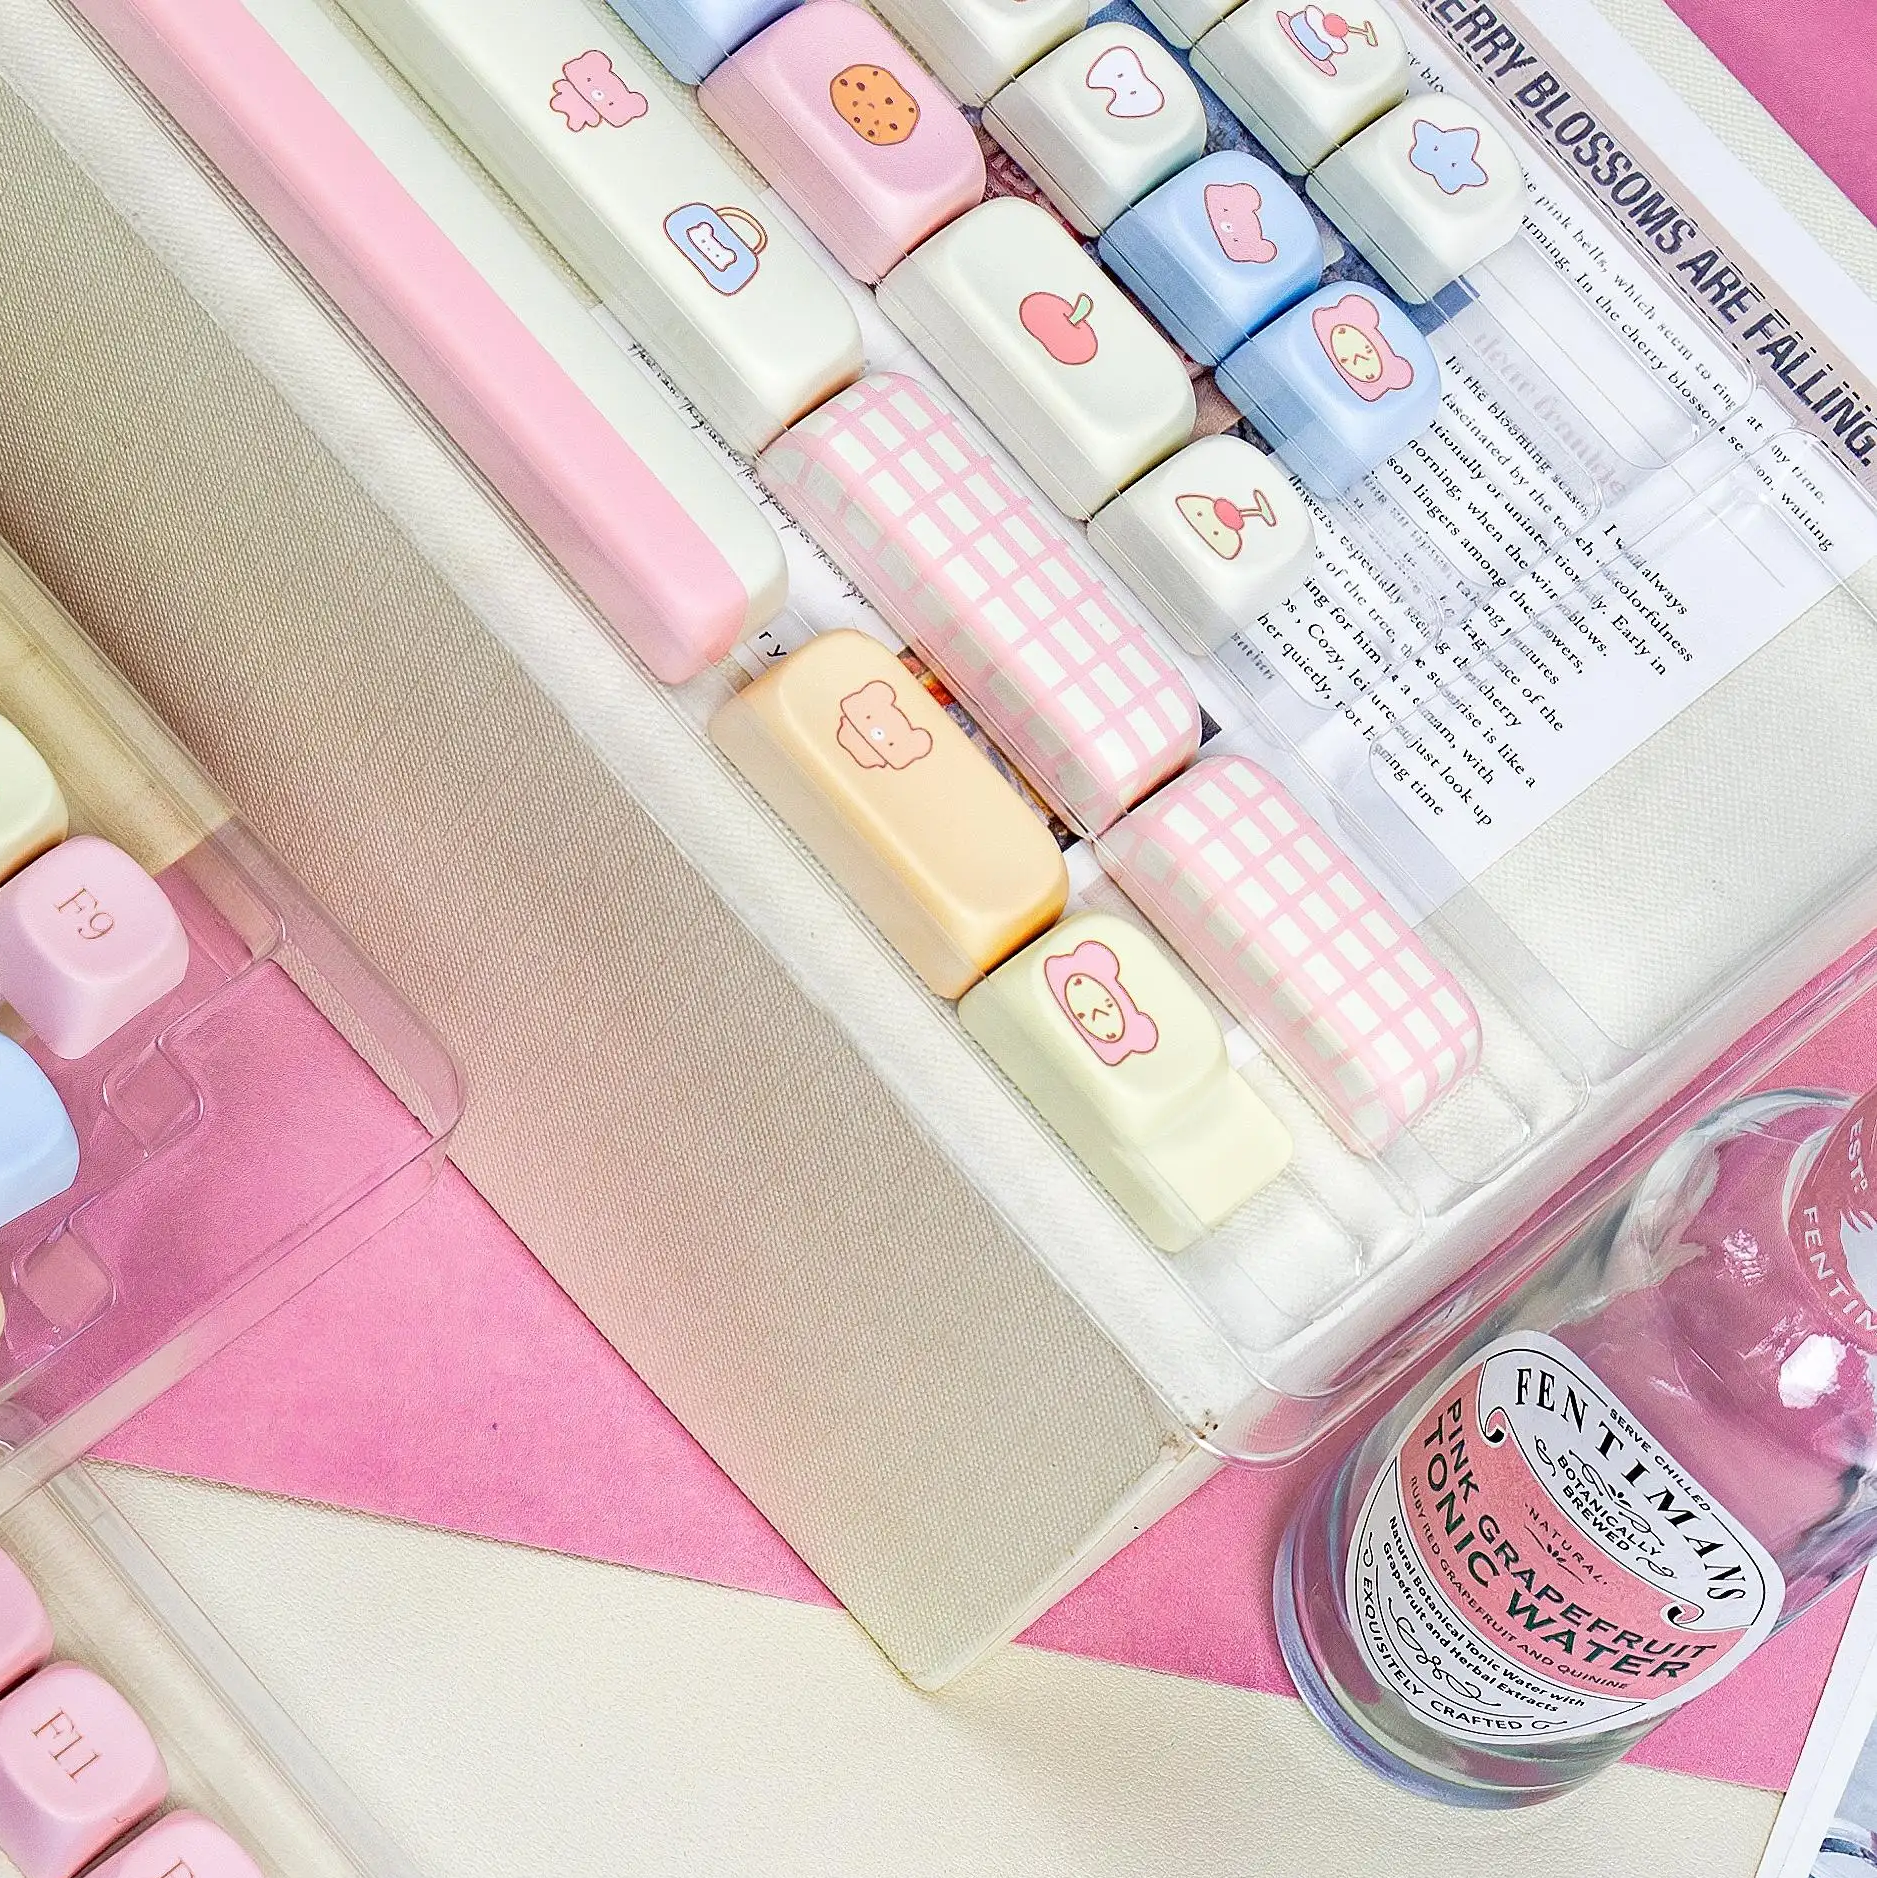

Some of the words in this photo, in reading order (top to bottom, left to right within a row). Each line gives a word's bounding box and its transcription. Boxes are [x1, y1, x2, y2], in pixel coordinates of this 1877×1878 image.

[1425, 0, 1537, 78] ERRY
[1513, 71, 1696, 255] BLOSSOMS
[1676, 246, 1766, 326] ARE
[1412, 482, 1461, 537] lingers
[1459, 539, 1508, 589] among
[1466, 500, 1504, 544] when
[1640, 567, 1689, 616] always
[1328, 606, 1354, 632] for
[1351, 629, 1382, 666] him
[1461, 747, 1495, 786] with
[1609, 613, 1652, 657] Early
[1255, 611, 1284, 640] her
[1280, 642, 1333, 701] quietly,
[1409, 779, 1445, 817] time
[1306, 622, 1346, 672] Cozy,
[1405, 736, 1441, 769] just
[1438, 765, 1473, 805] look
[1496, 742, 1526, 776] like
[55, 887, 114, 940] F9
[1444, 1397, 1478, 1495] PINK
[1478, 1517, 1717, 1659] GRAPEFRUIT
[1515, 1368, 1746, 1604] FENTIMANS
[1556, 1454, 1664, 1558] BOTANICALLY
[1562, 1485, 1633, 1552] BREWED
[1609, 1408, 1651, 1451] SERVE
[1654, 1442, 1712, 1513] CHILLED
[1388, 1516, 1417, 1576] Natural
[1414, 1569, 1465, 1636] Botanical
[1466, 1634, 1501, 1666] Tonic
[1503, 1665, 1546, 1698] Water
[1548, 1691, 1585, 1708] with
[1410, 1476, 1430, 1524] RUBY
[1422, 1528, 1443, 1559] RED
[1438, 1557, 1516, 1644] GRAPEFRUIT
[1520, 1644, 1555, 1666] AND
[1557, 1664, 1628, 1691] QUININE
[1423, 1415, 1504, 1589] TONIC
[1506, 1592, 1692, 1681] WATER
[1362, 1578, 1424, 1698] EXQUISITELY
[1430, 1701, 1523, 1731] CRAFTED
[1383, 1543, 1428, 1630] Grapefruit
[1424, 1628, 1450, 1654] and
[1449, 1651, 1495, 1687] Herbal
[1496, 1682, 1560, 1712] Extracts
[33, 1710, 100, 1782] F11
